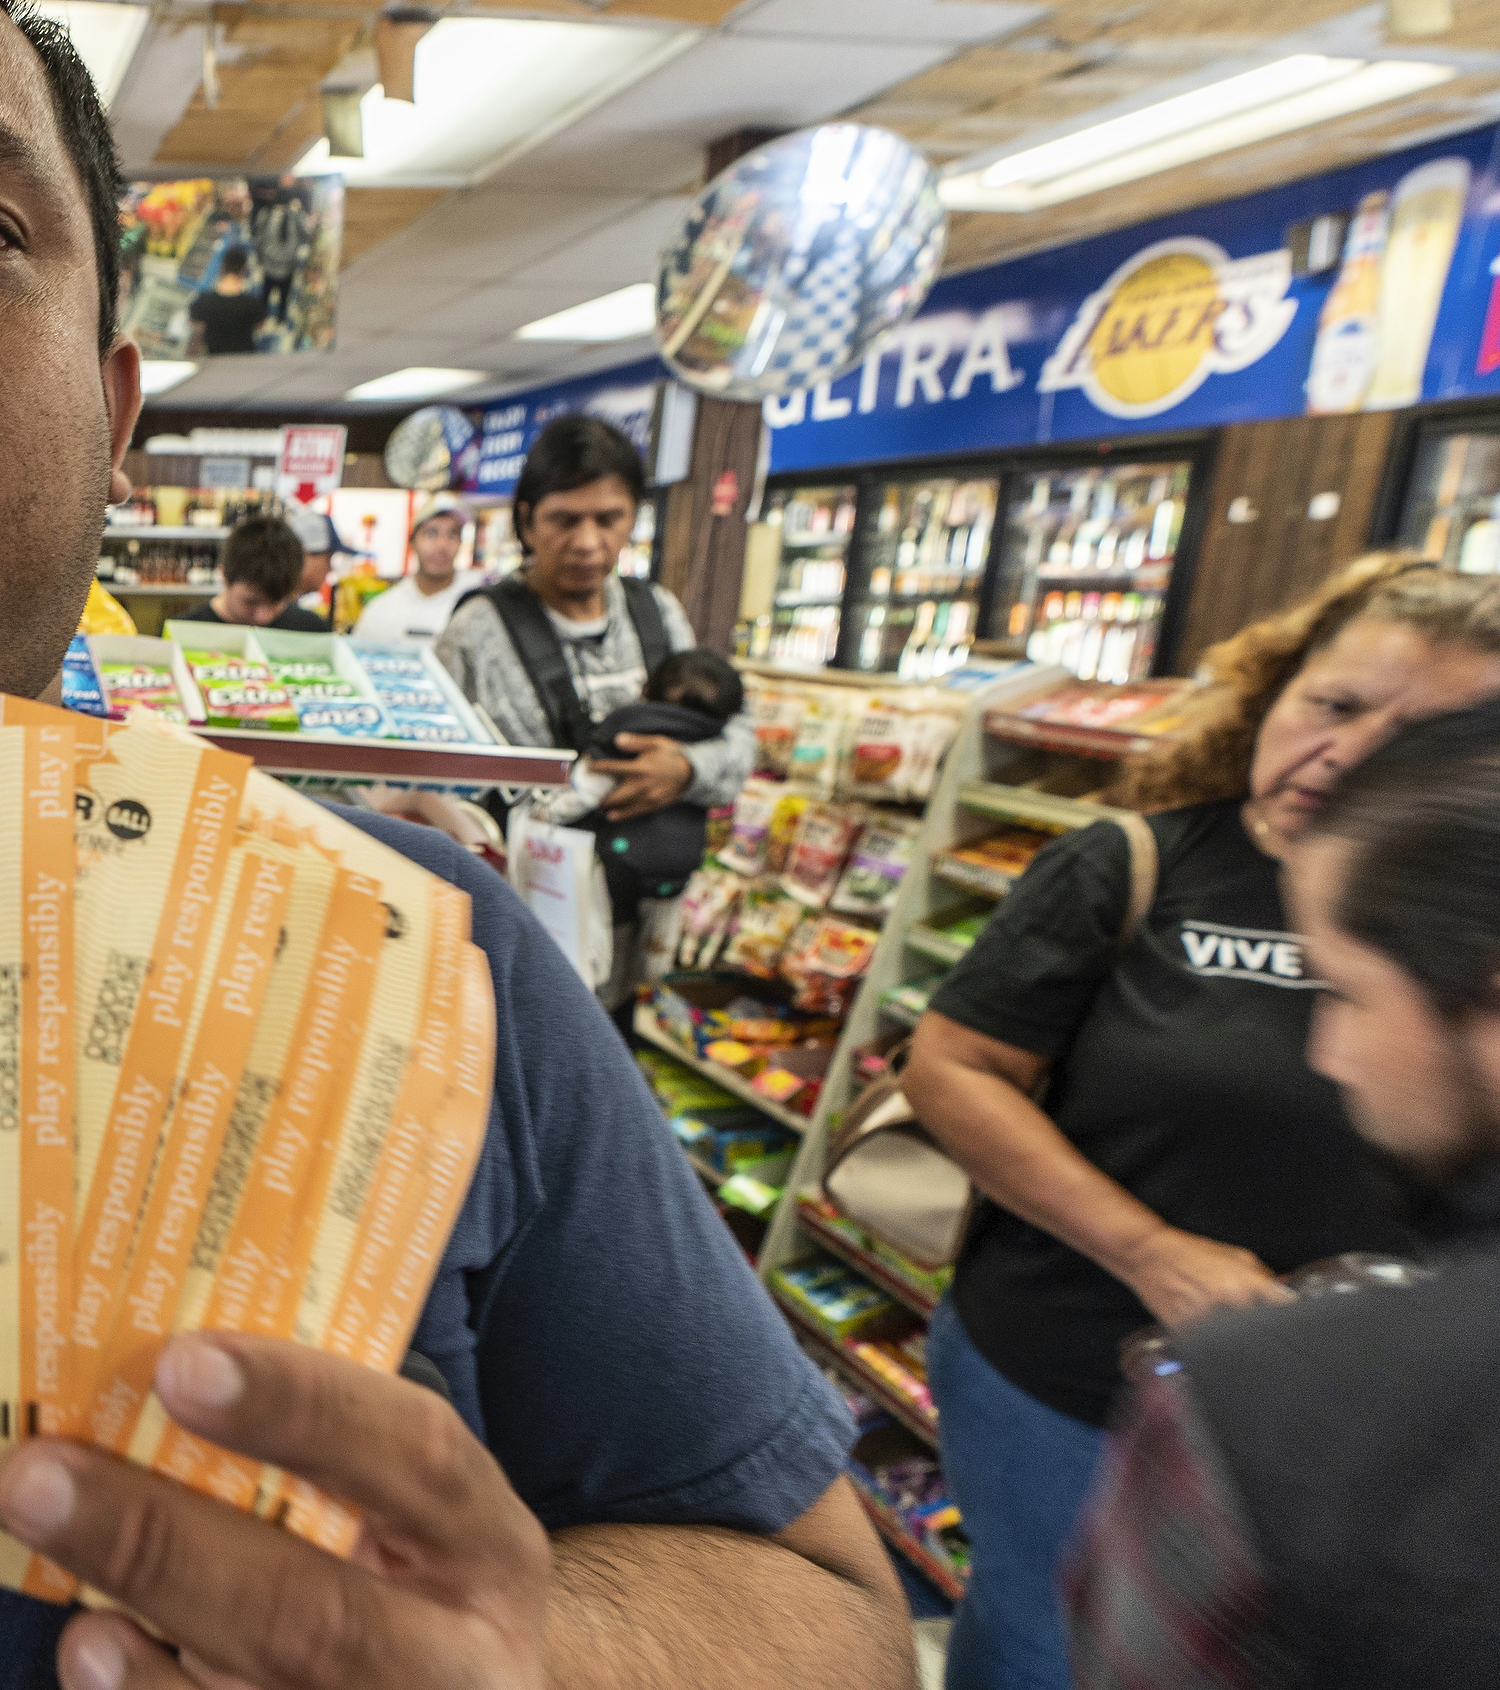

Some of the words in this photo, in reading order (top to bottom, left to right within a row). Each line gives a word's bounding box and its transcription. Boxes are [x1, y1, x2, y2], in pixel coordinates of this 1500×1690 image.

[29, 753, 69, 819] play
[171, 774, 238, 950] responsibly
[27, 871, 67, 1065] responsibly
[151, 948, 195, 1028] play
[219, 937, 266, 1016] play
[1180, 930, 1303, 978] VIVE
[26, 1073, 66, 1147] play
[88, 1074, 164, 1270] responsibly
[155, 1061, 232, 1258] responsibly
[262, 1117, 310, 1196] play
[26, 1201, 66, 1394] responsibly
[71, 1273, 112, 1349] play
[131, 1258, 178, 1335] play
